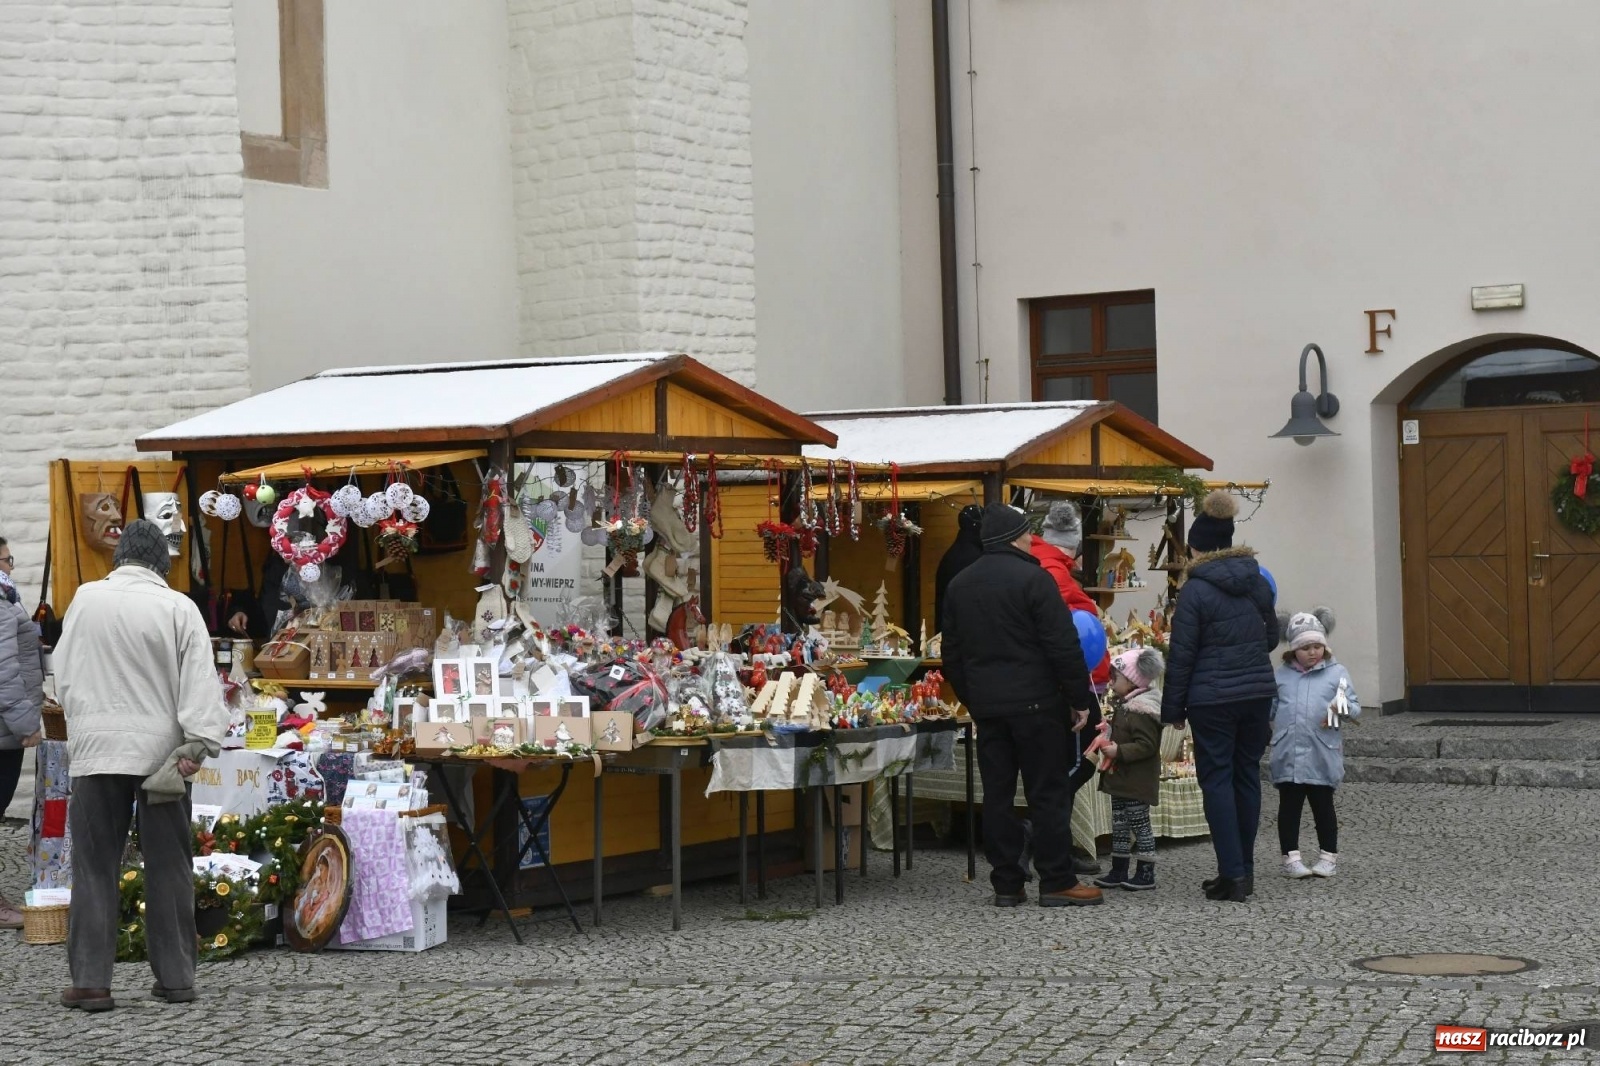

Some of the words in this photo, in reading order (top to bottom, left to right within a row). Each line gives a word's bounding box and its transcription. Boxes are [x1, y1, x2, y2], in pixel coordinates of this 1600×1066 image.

[1363, 309, 1396, 354] F
[530, 562, 545, 573] INA
[531, 577, 575, 589] WY-WIEPRZ
